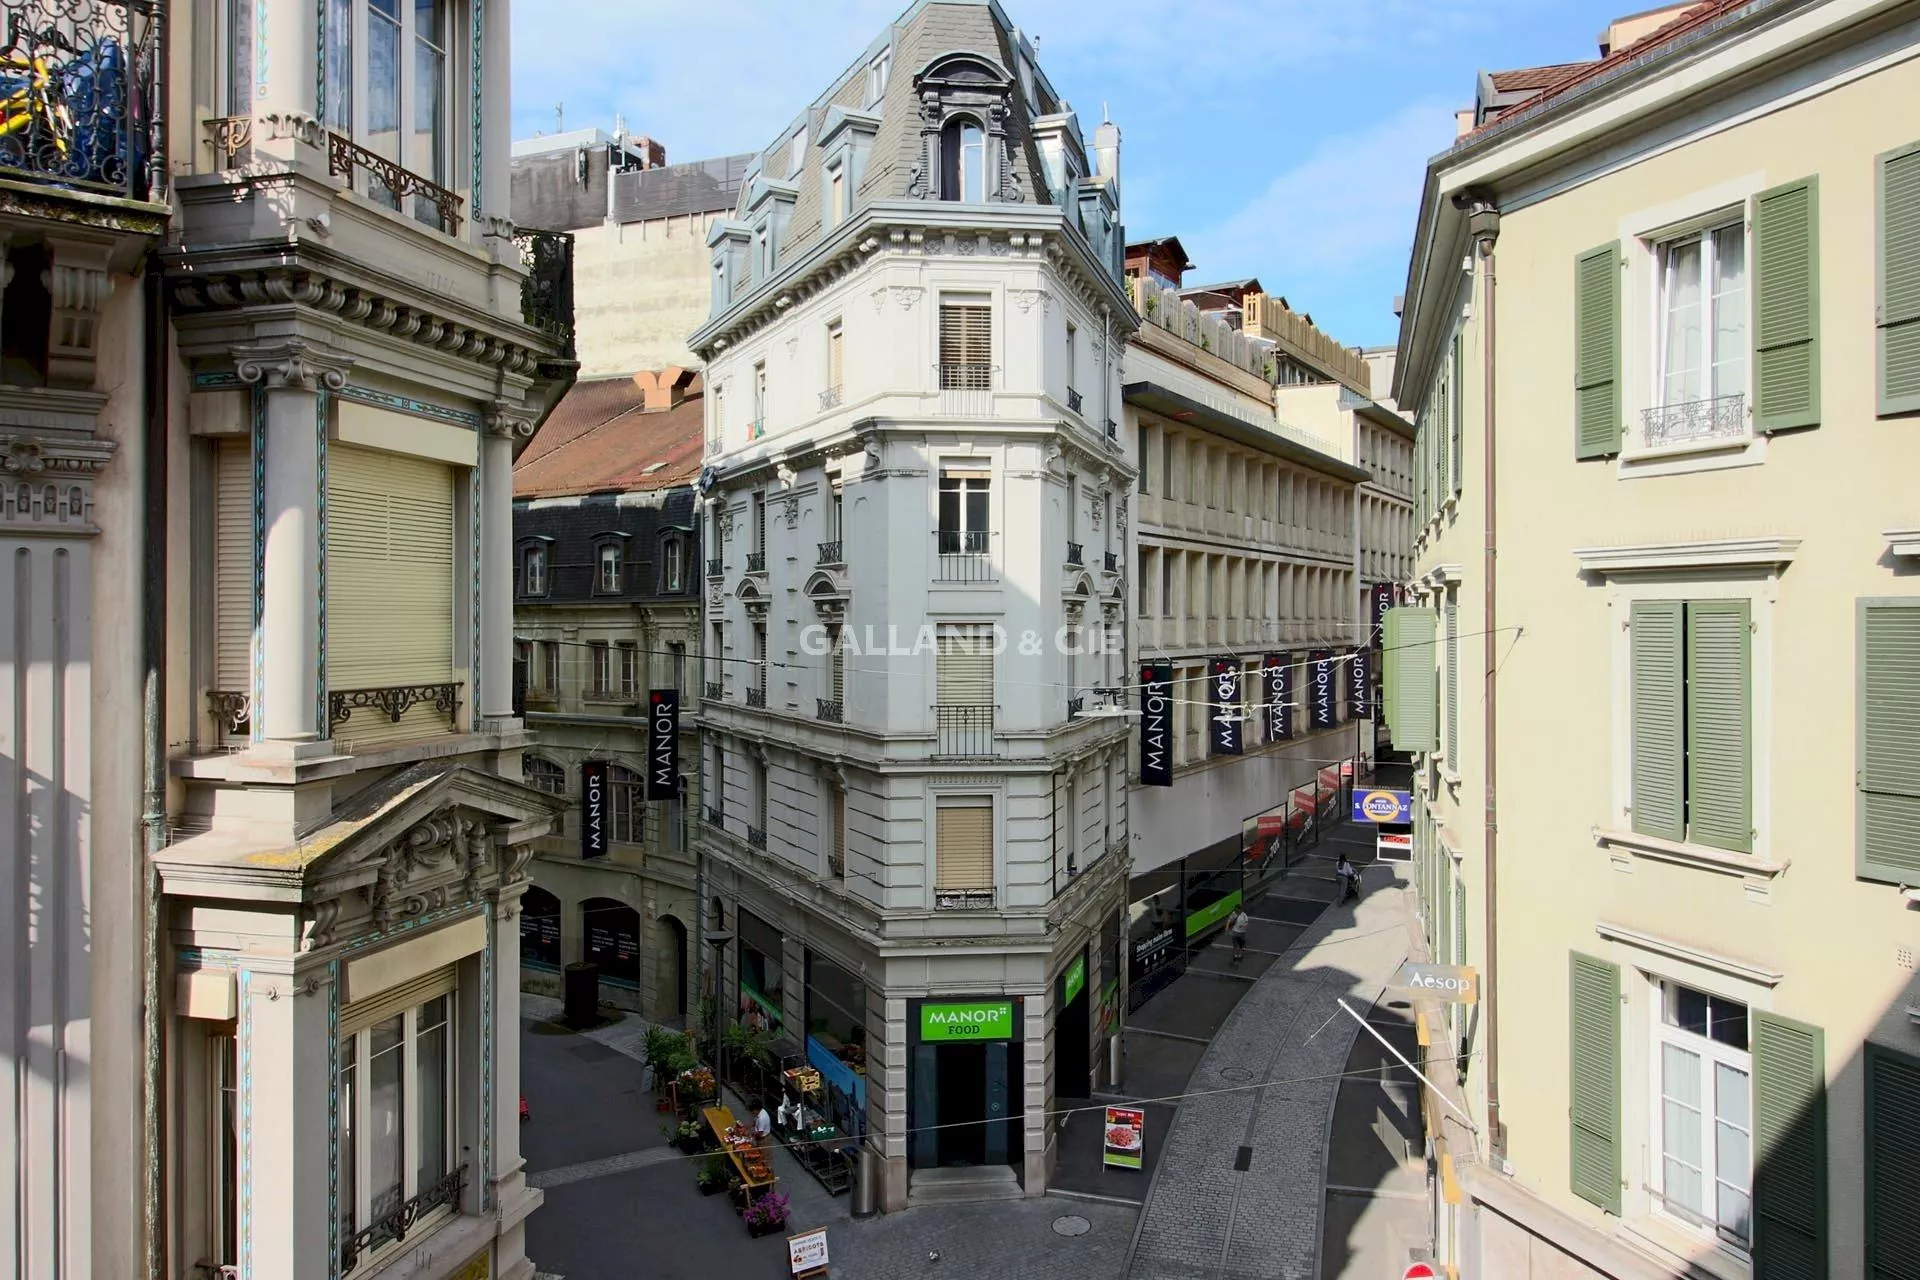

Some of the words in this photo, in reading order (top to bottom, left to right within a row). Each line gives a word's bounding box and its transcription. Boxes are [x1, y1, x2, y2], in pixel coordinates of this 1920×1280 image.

[1272, 665, 1285, 734] MANOR
[1317, 660, 1329, 723] MANOR
[1353, 657, 1365, 714] MANOR
[655, 703, 673, 786] MANOR
[1147, 681, 1164, 770] MANOR
[589, 775, 601, 849] MANOR
[929, 1009, 999, 1024] MANOR
[948, 1025, 981, 1035] FOOD
